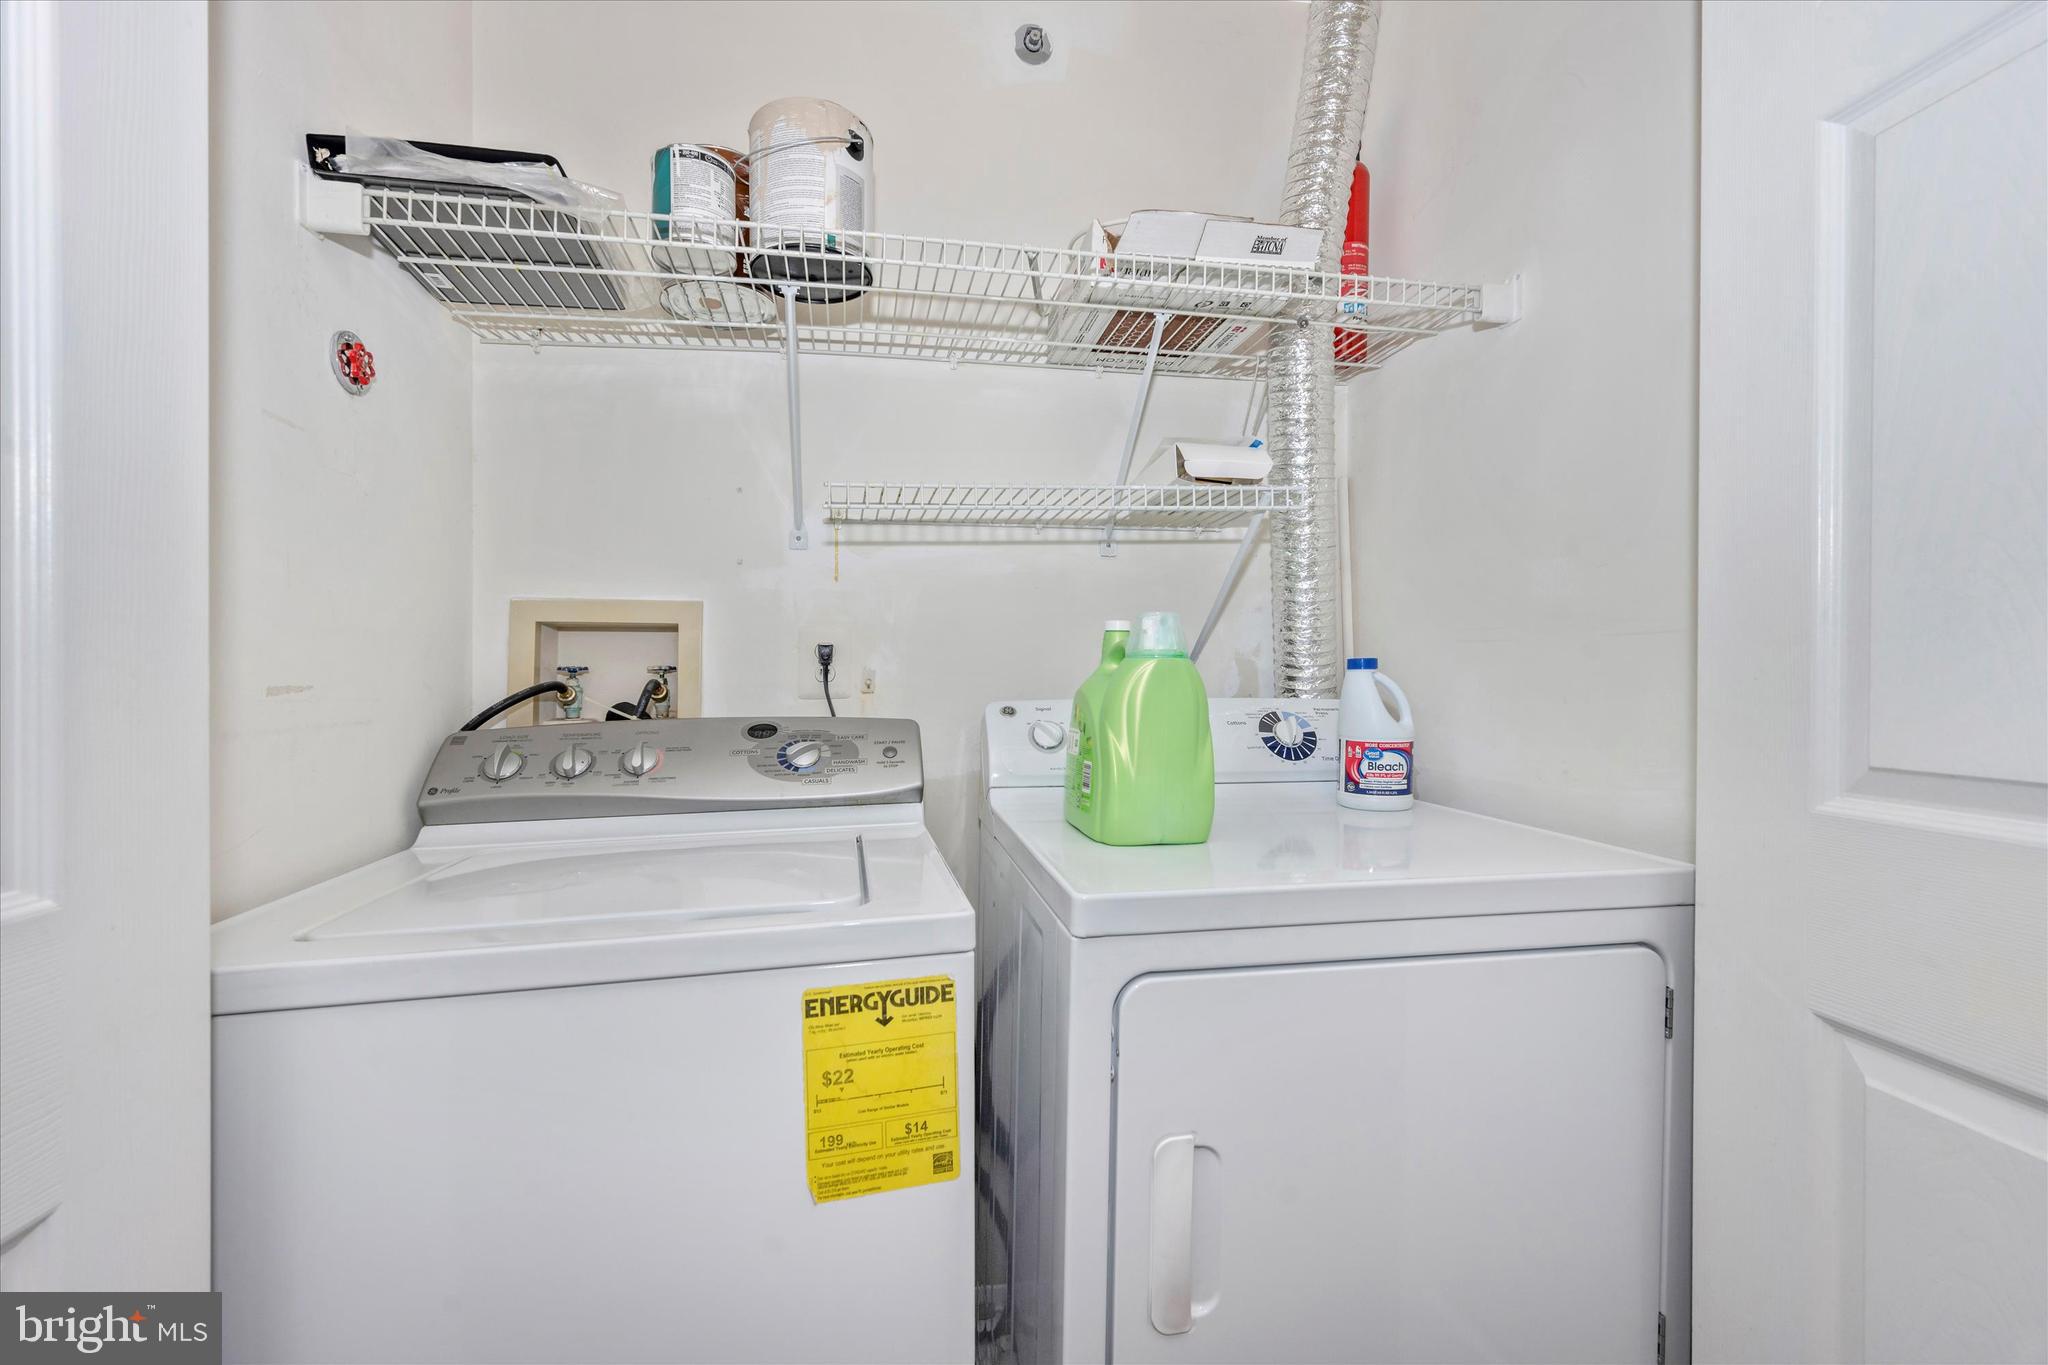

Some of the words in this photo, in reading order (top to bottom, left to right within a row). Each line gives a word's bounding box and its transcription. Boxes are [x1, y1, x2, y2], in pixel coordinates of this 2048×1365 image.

[1368, 762, 1404, 771] Bleach
[805, 984, 954, 1018] ENERGYGUIDE
[840, 1050, 866, 1058] Estimated
[884, 1044, 912, 1054] Operating
[822, 1068, 854, 1088] $22
[905, 1120, 928, 1136] $14
[820, 1134, 844, 1148] 199
[857, 1154, 876, 1164] depend
[885, 1152, 896, 1160] your
